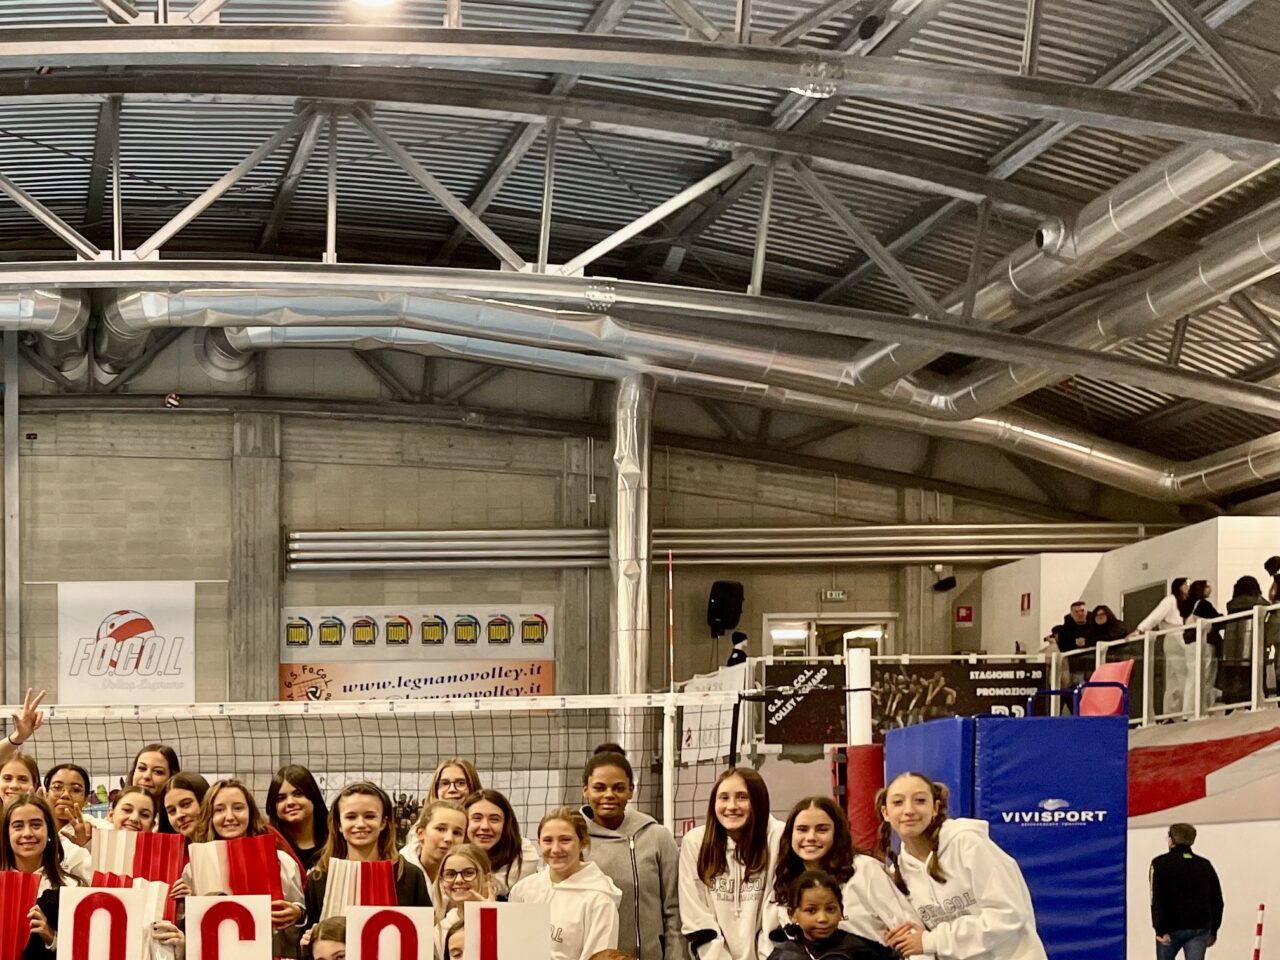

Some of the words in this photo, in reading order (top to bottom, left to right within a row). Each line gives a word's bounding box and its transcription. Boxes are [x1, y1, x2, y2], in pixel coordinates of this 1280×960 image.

[343, 664, 541, 692] www.legnanovolley.it
[969, 671, 1014, 679] STAGIONE
[1031, 670, 1042, 679] 20
[768, 698, 798, 726] VOLLEY
[1001, 811, 1108, 823] VIVISPORT
